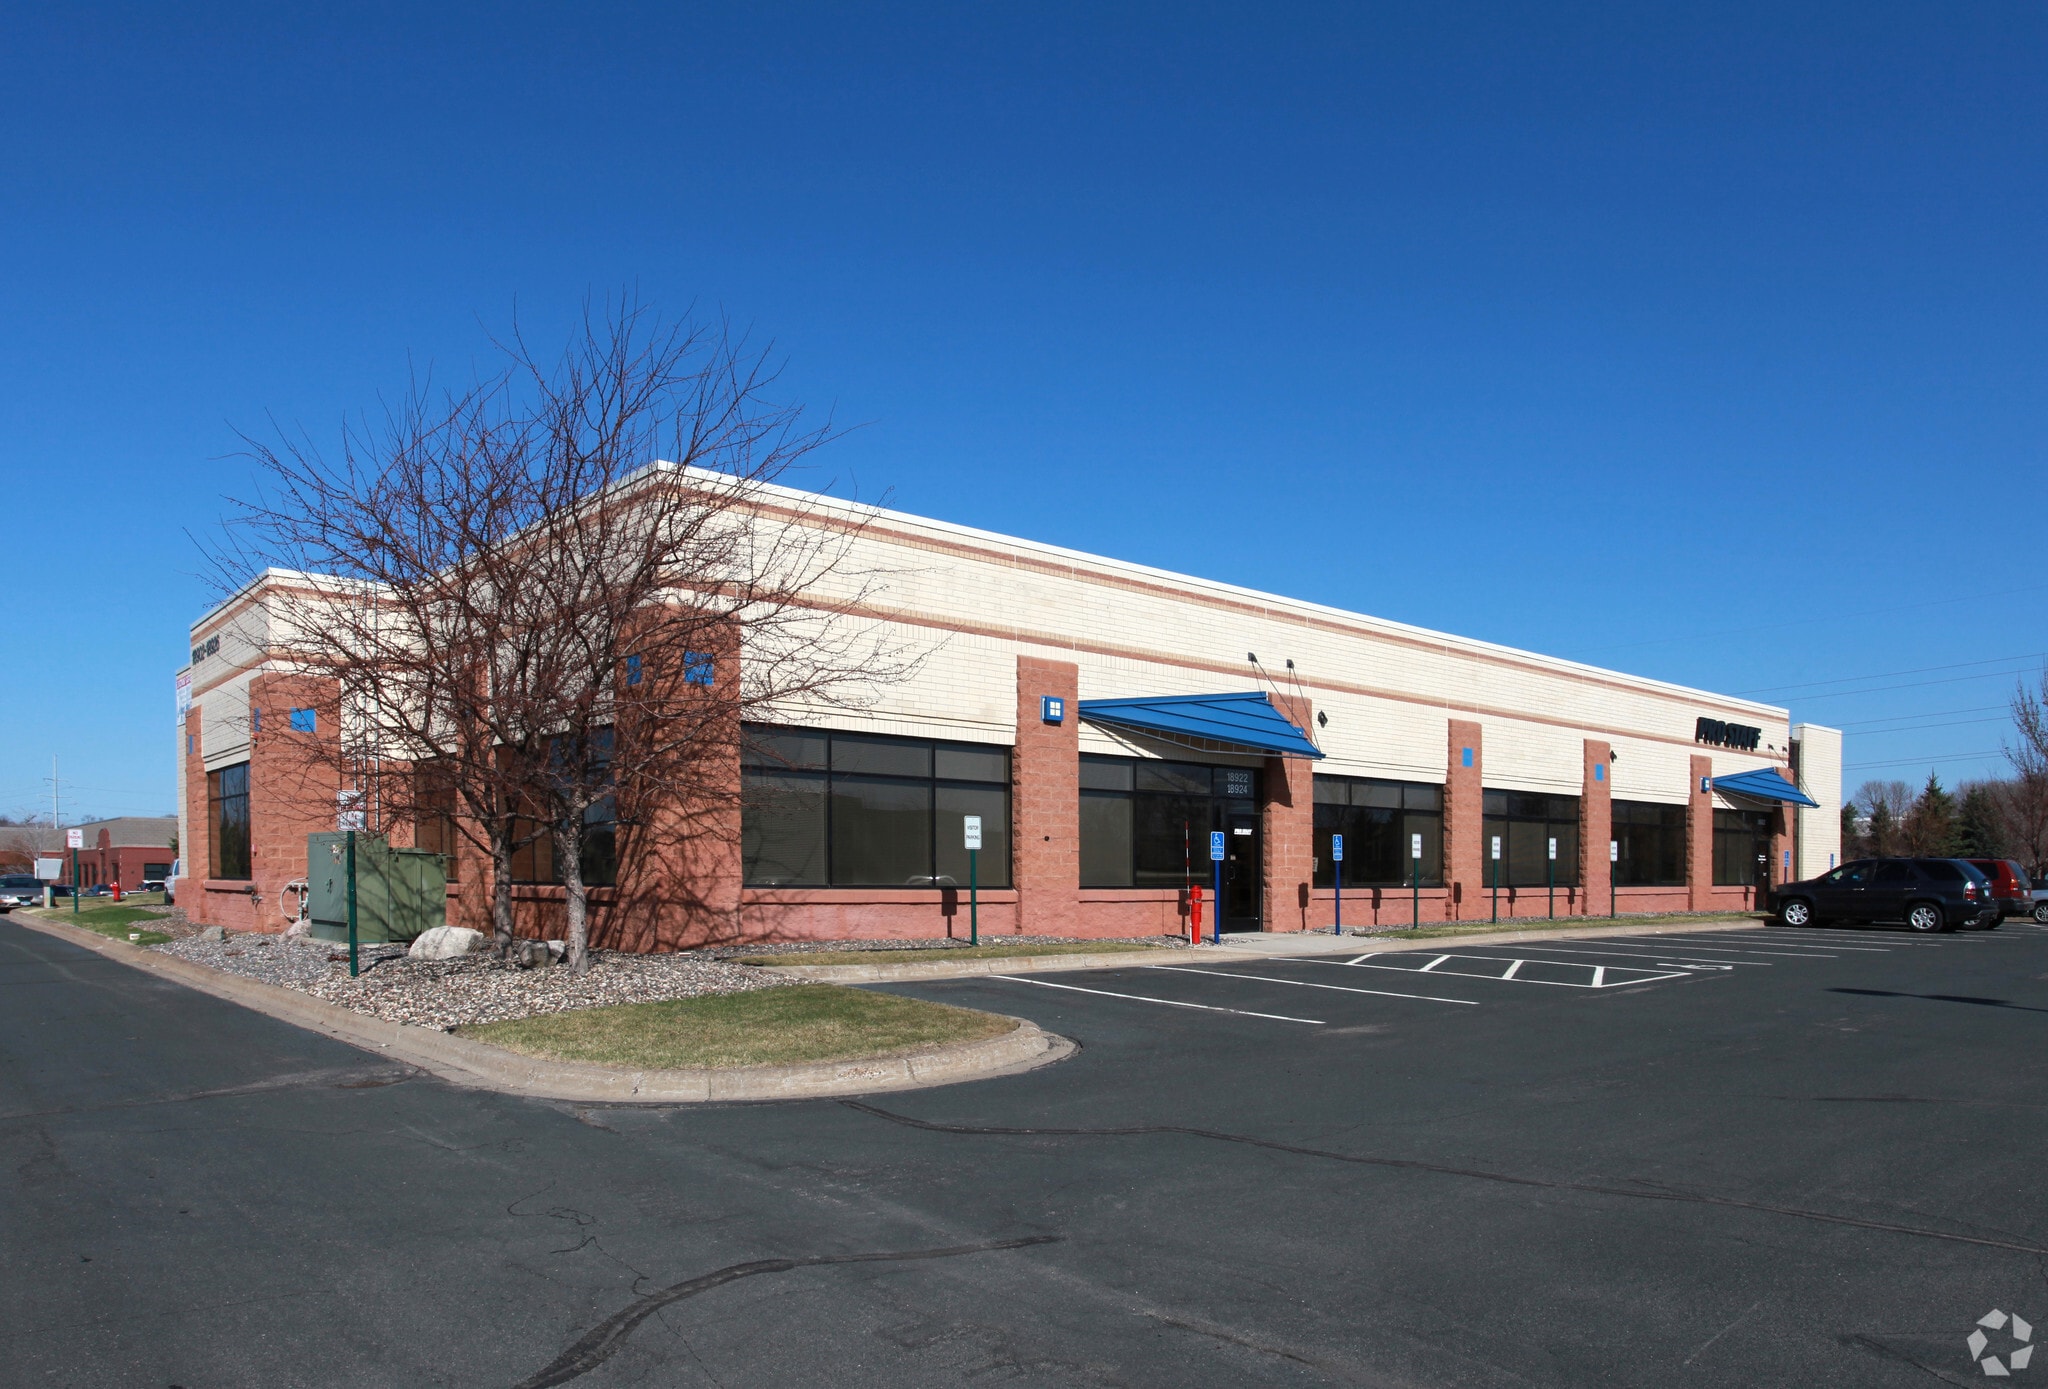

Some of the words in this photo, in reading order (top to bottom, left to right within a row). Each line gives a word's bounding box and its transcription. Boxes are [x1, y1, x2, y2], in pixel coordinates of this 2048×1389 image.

[1695, 716, 1726, 746] PRO
[1724, 723, 1761, 752] STAFF
[1227, 772, 1248, 782] 18922
[1227, 784, 1248, 794] 18924
